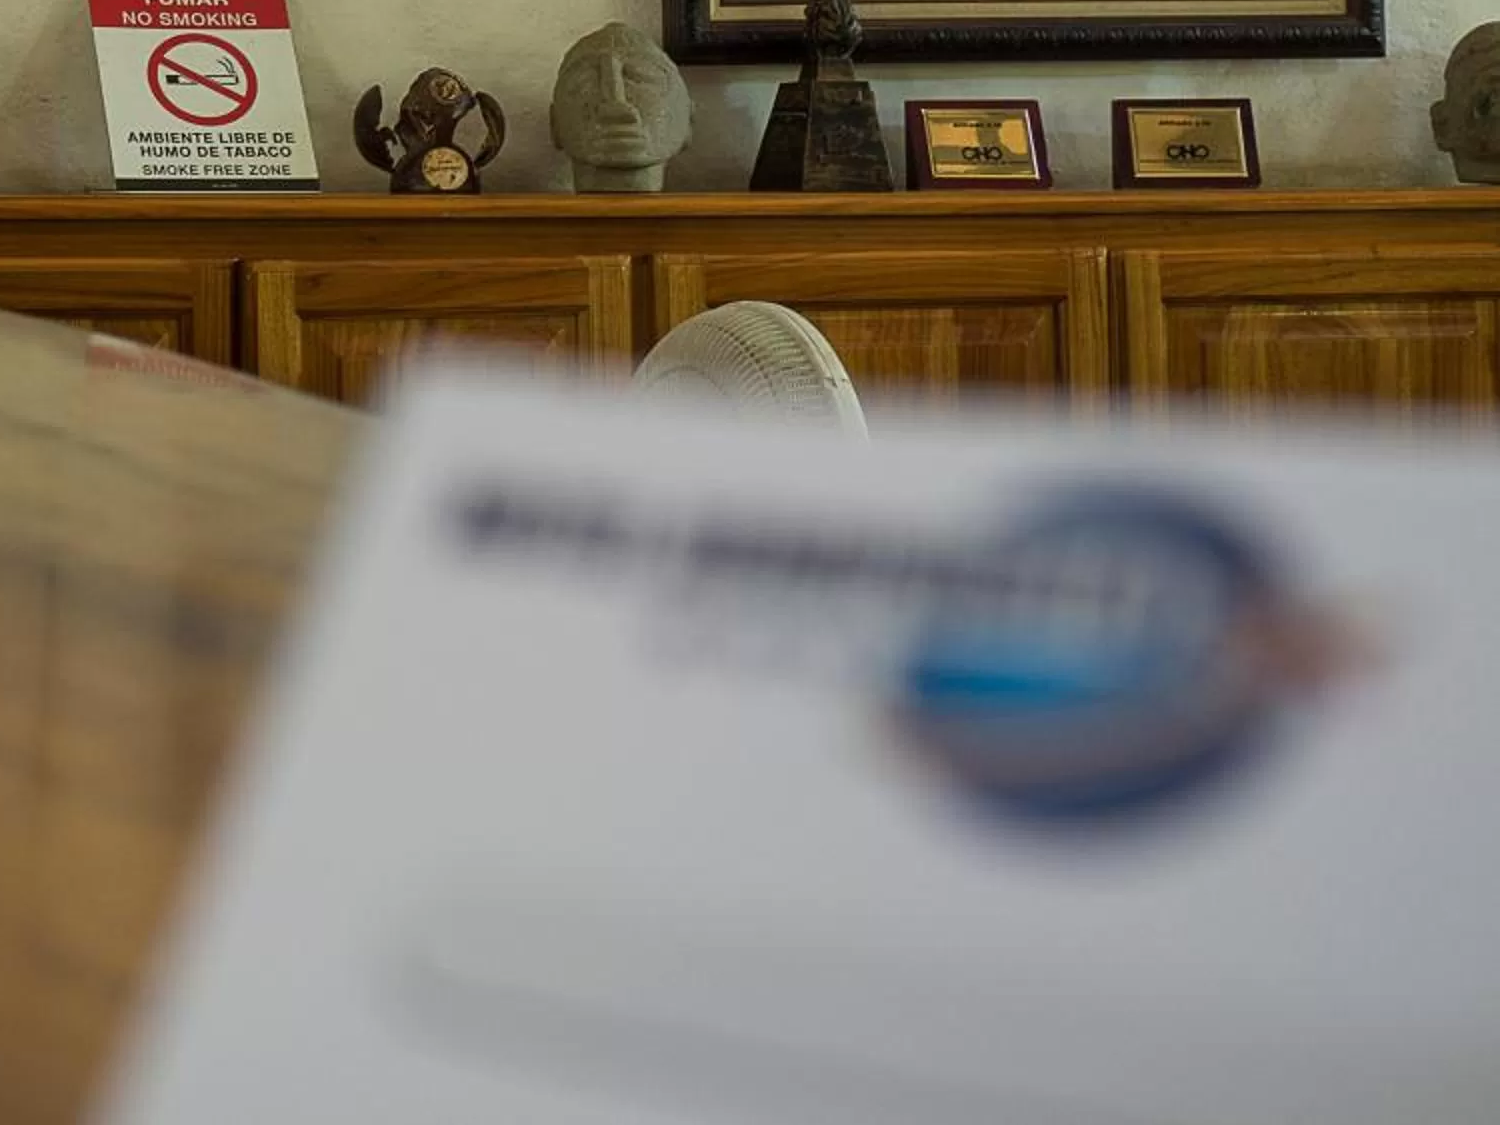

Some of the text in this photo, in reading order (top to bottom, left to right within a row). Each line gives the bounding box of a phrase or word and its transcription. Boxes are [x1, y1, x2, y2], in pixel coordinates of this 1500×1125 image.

[122, 11, 258, 26] NO SMOKING
[127, 131, 296, 144] AMBIENTE LIBRE DE
[140, 146, 292, 158] HUMO DE TABACO
[142, 164, 292, 176] SMOKE FREE ZONE
